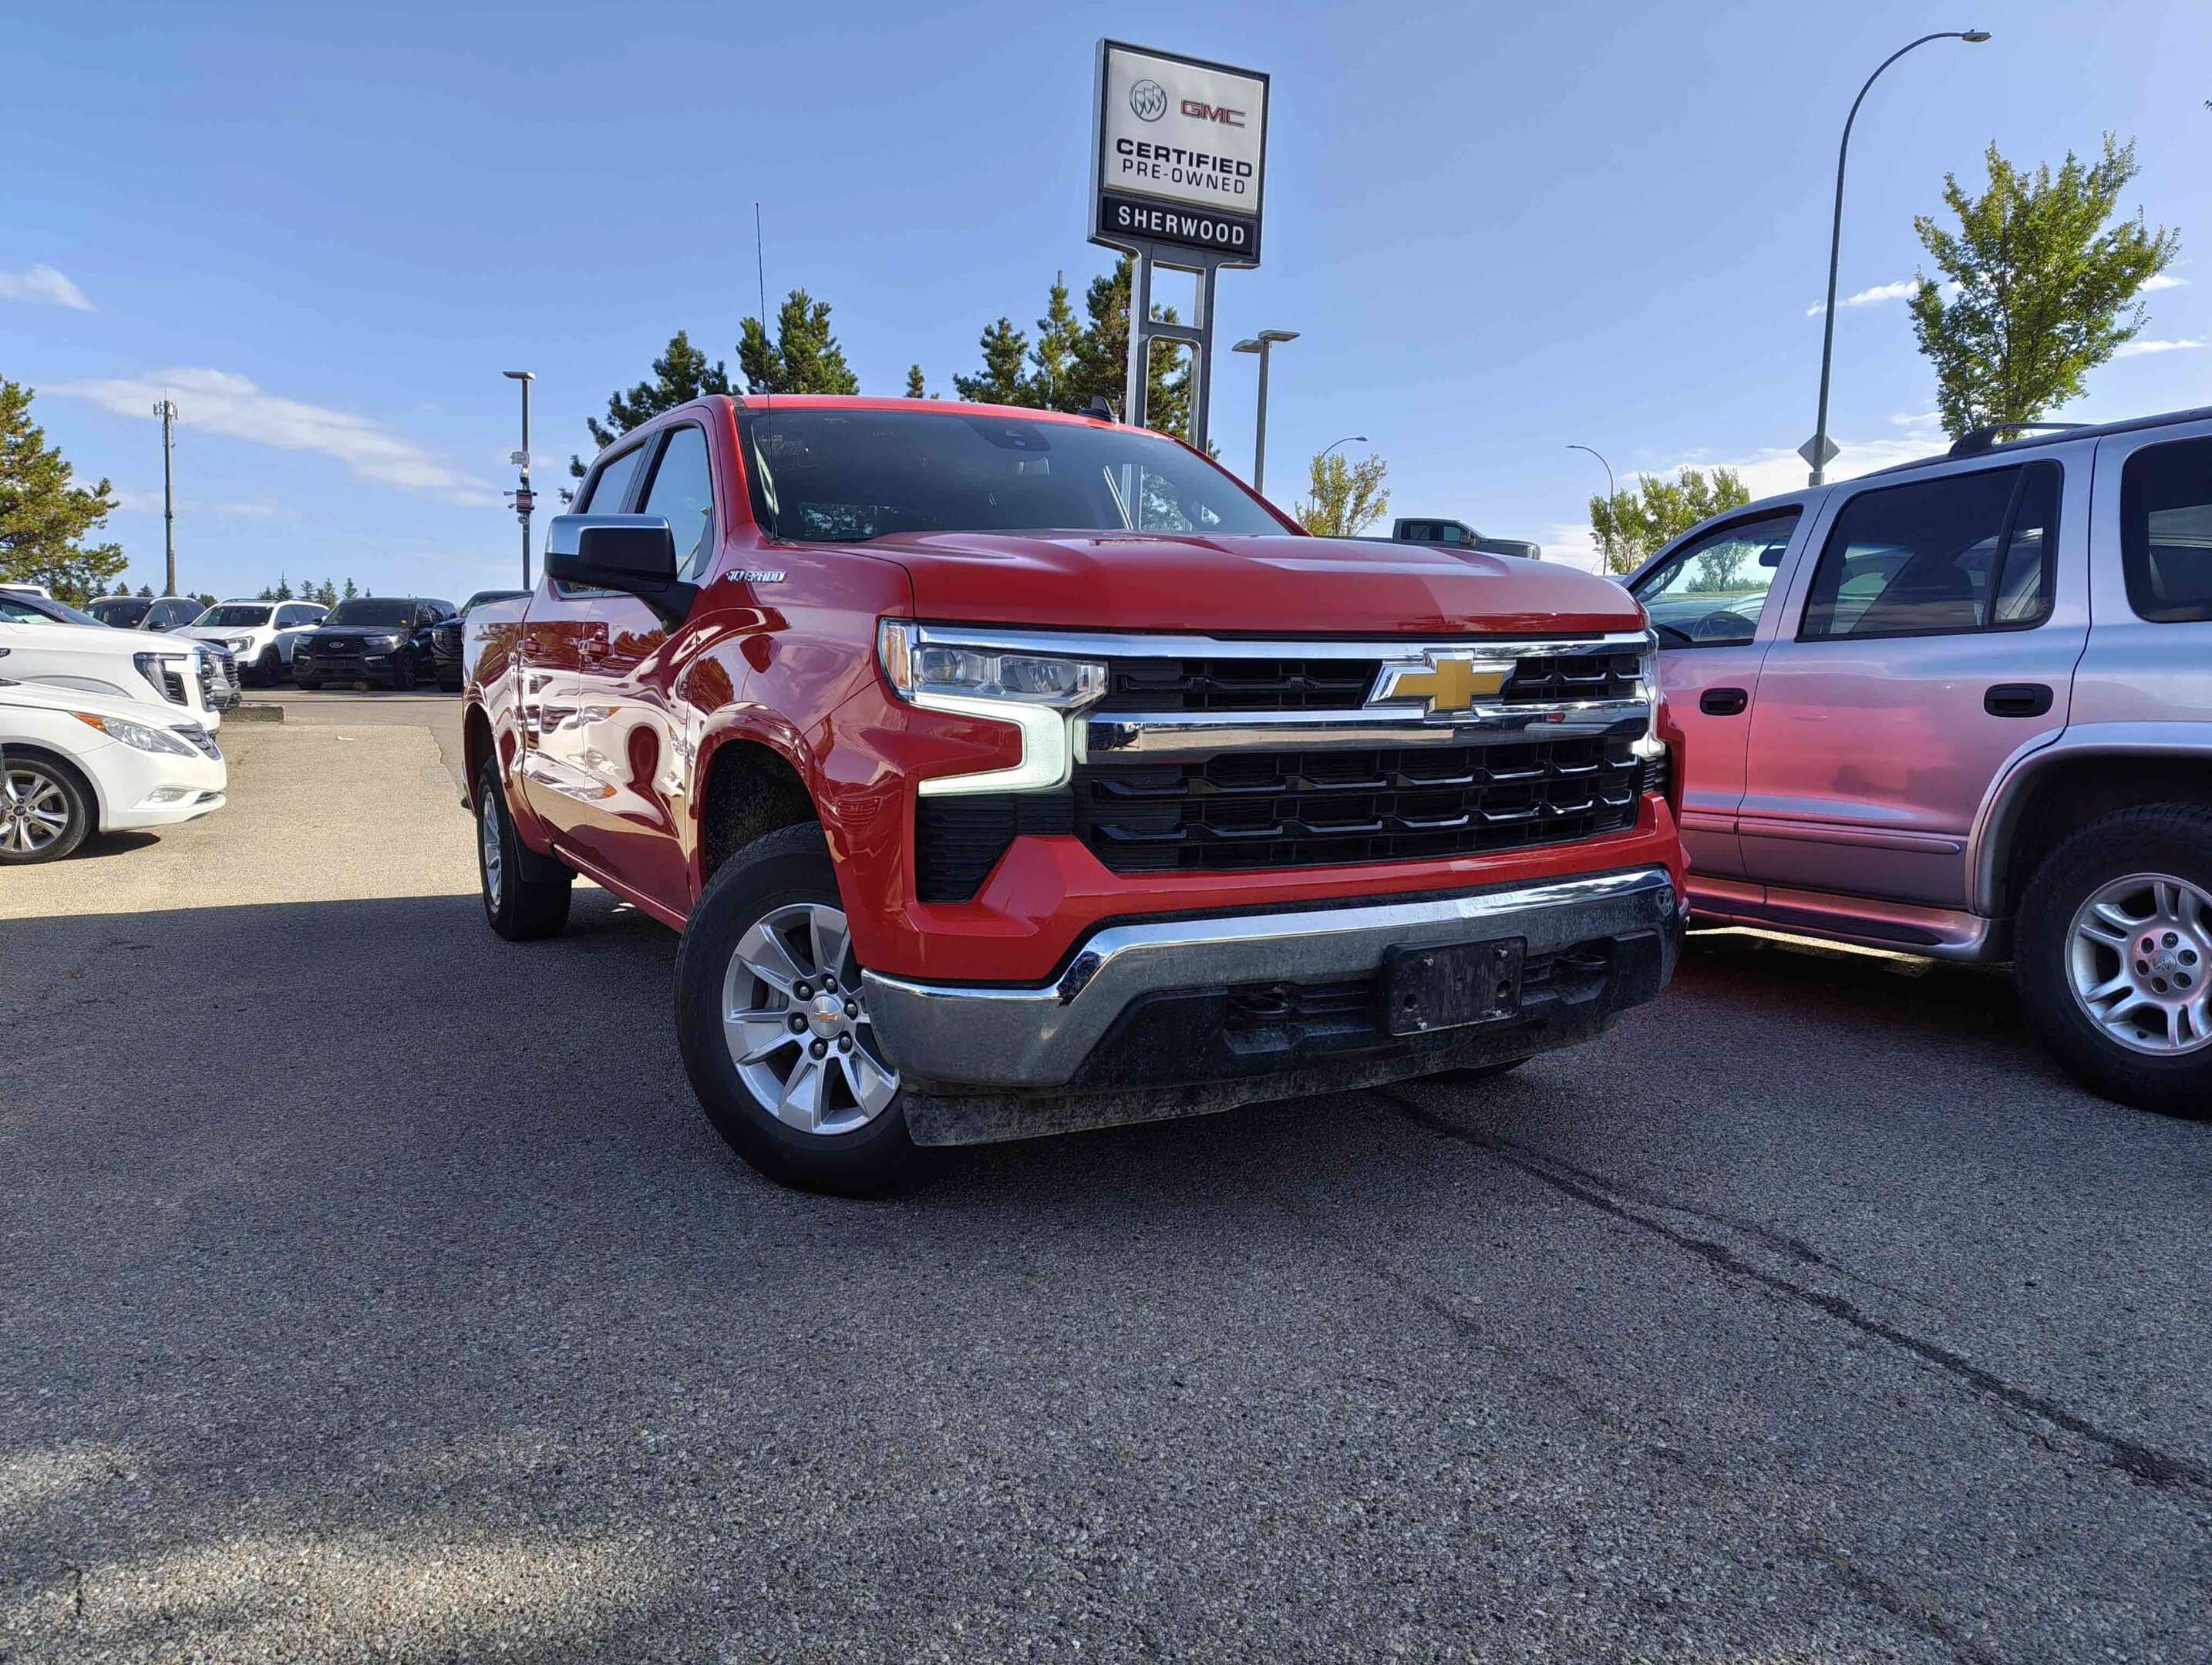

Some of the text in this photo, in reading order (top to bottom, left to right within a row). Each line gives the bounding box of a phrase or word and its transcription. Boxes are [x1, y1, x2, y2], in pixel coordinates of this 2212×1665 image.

[1181, 99, 1246, 129] GMC
[1116, 138, 1253, 177] CERTIFIED
[1123, 158, 1245, 194] PRE-OWNED
[1118, 205, 1245, 245] SHERWOOD
